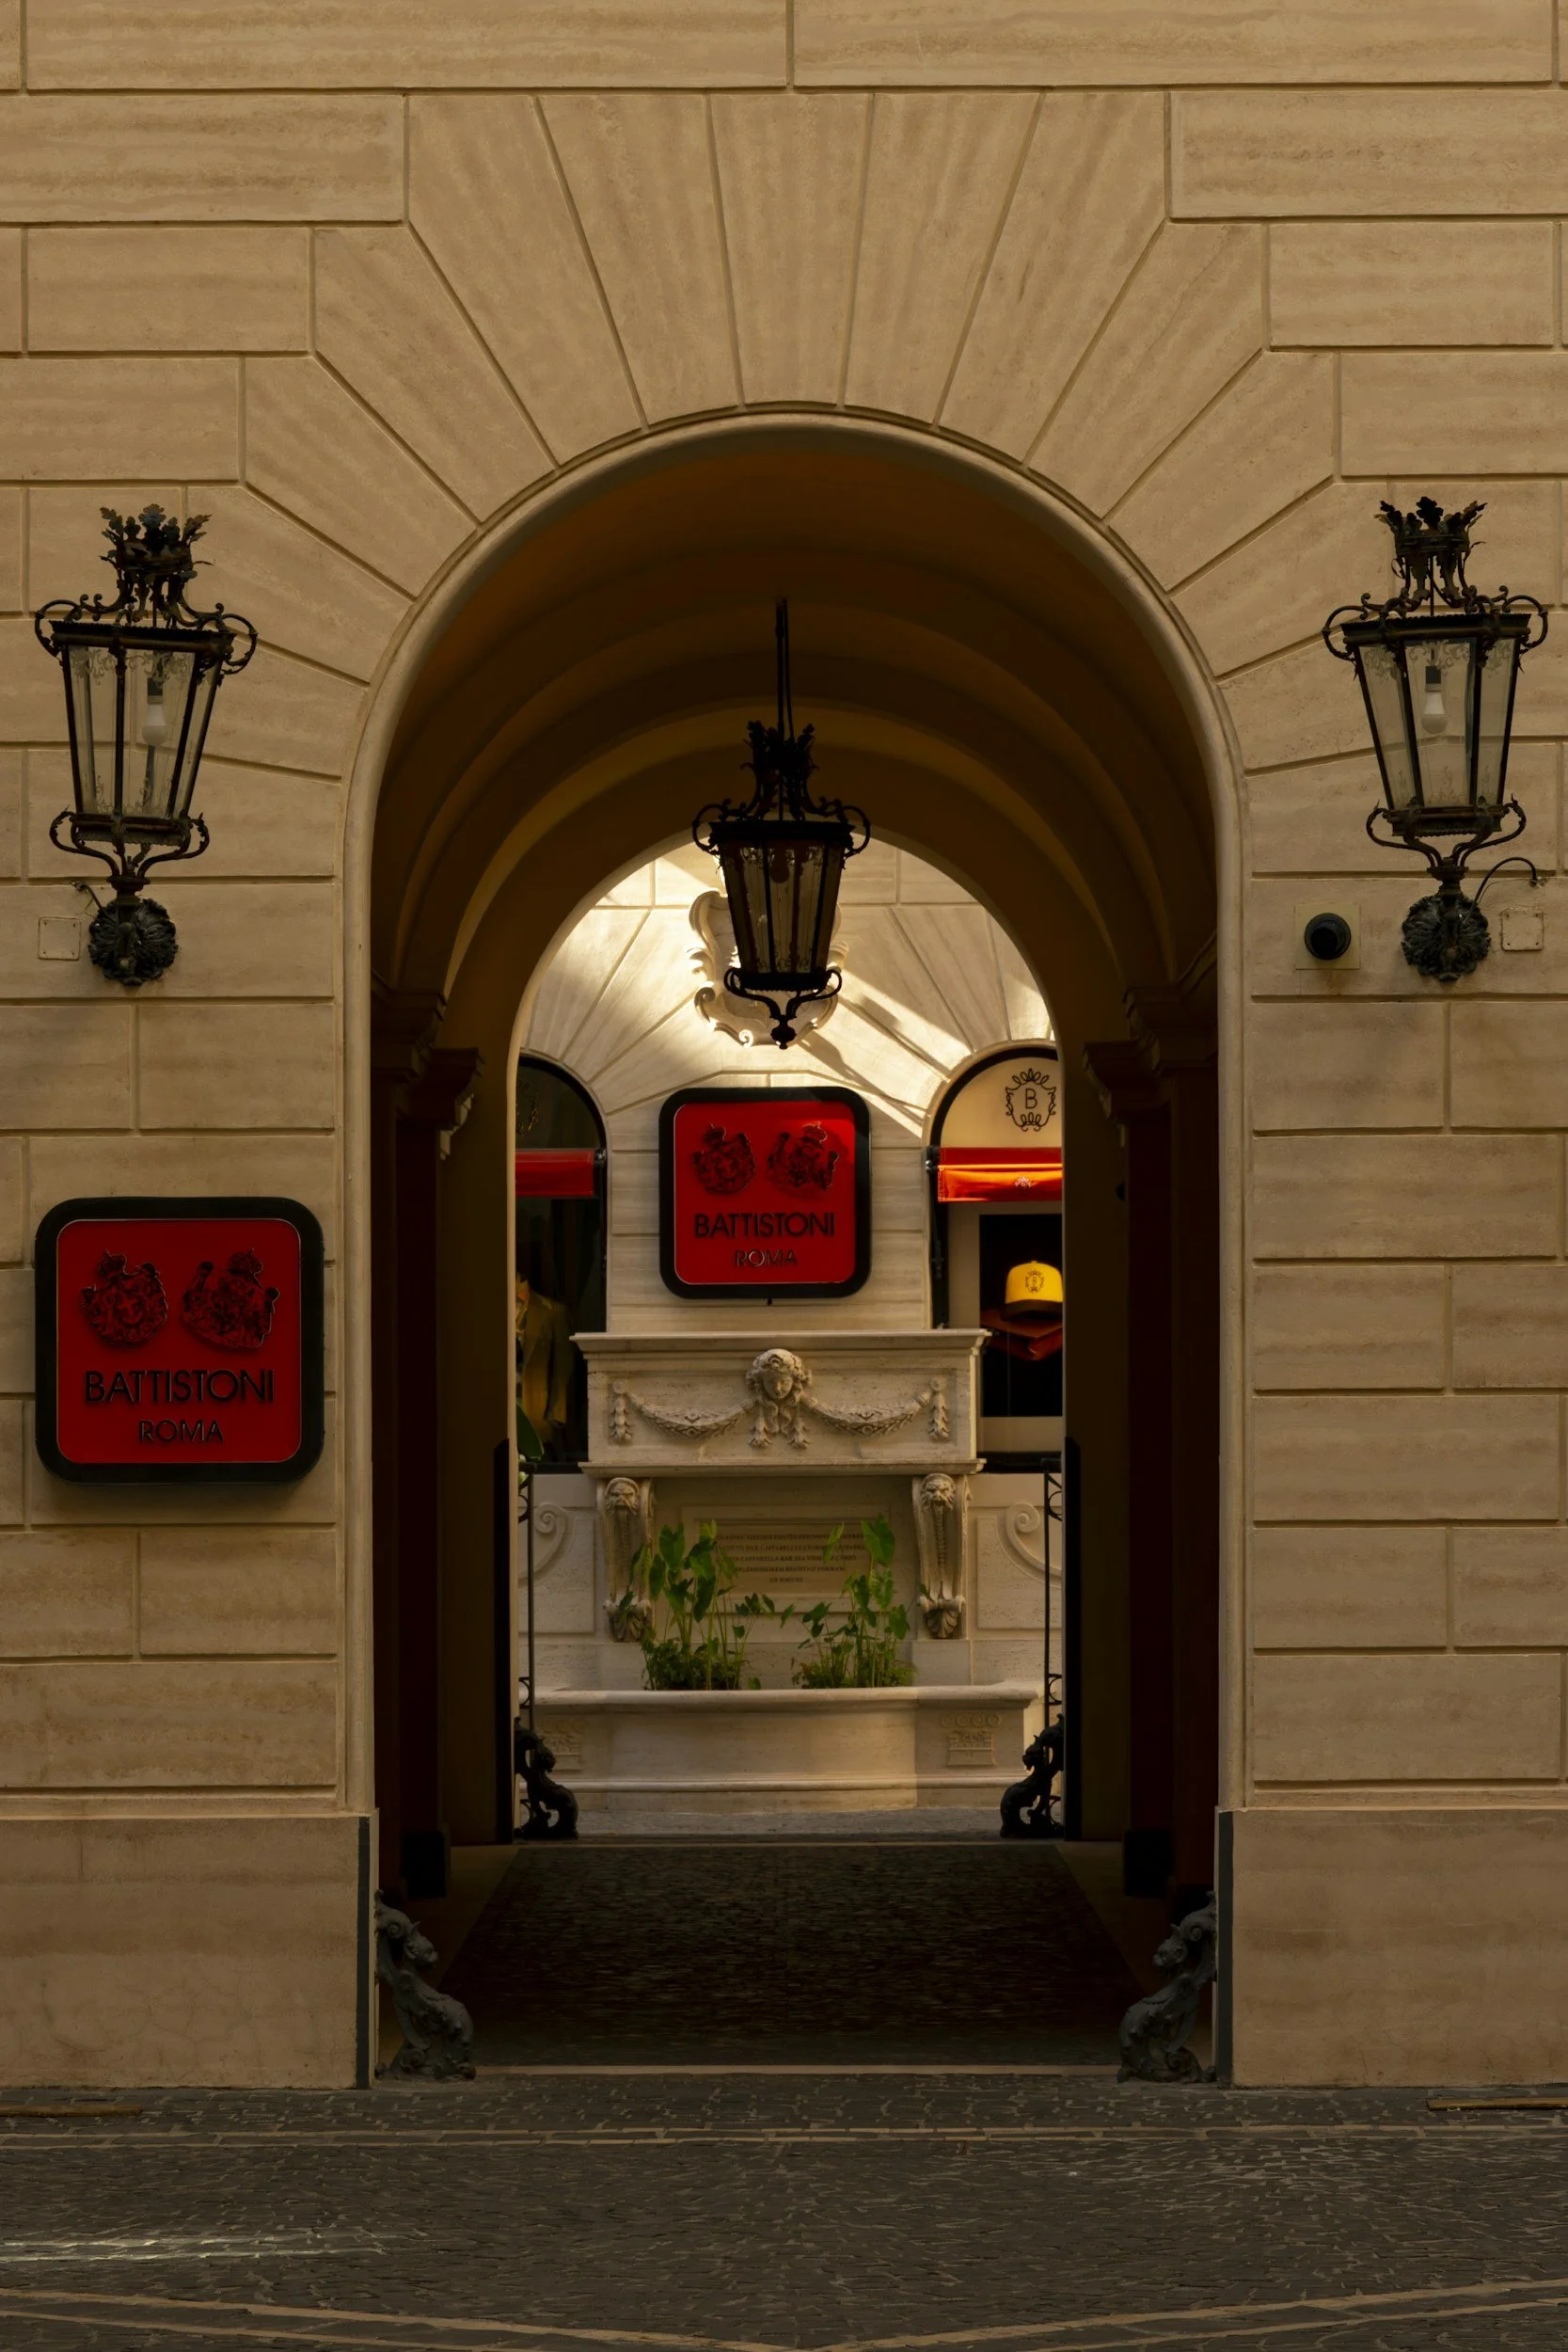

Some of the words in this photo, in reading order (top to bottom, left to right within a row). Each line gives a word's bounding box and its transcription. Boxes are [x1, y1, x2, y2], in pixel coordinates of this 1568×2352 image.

[1025, 1089, 1037, 1109] B
[694, 1212, 835, 1238] BATTISTONI
[736, 1248, 798, 1268] ROMA
[85, 1369, 275, 1404] BATTISTONI
[138, 1419, 224, 1443] ROMA
